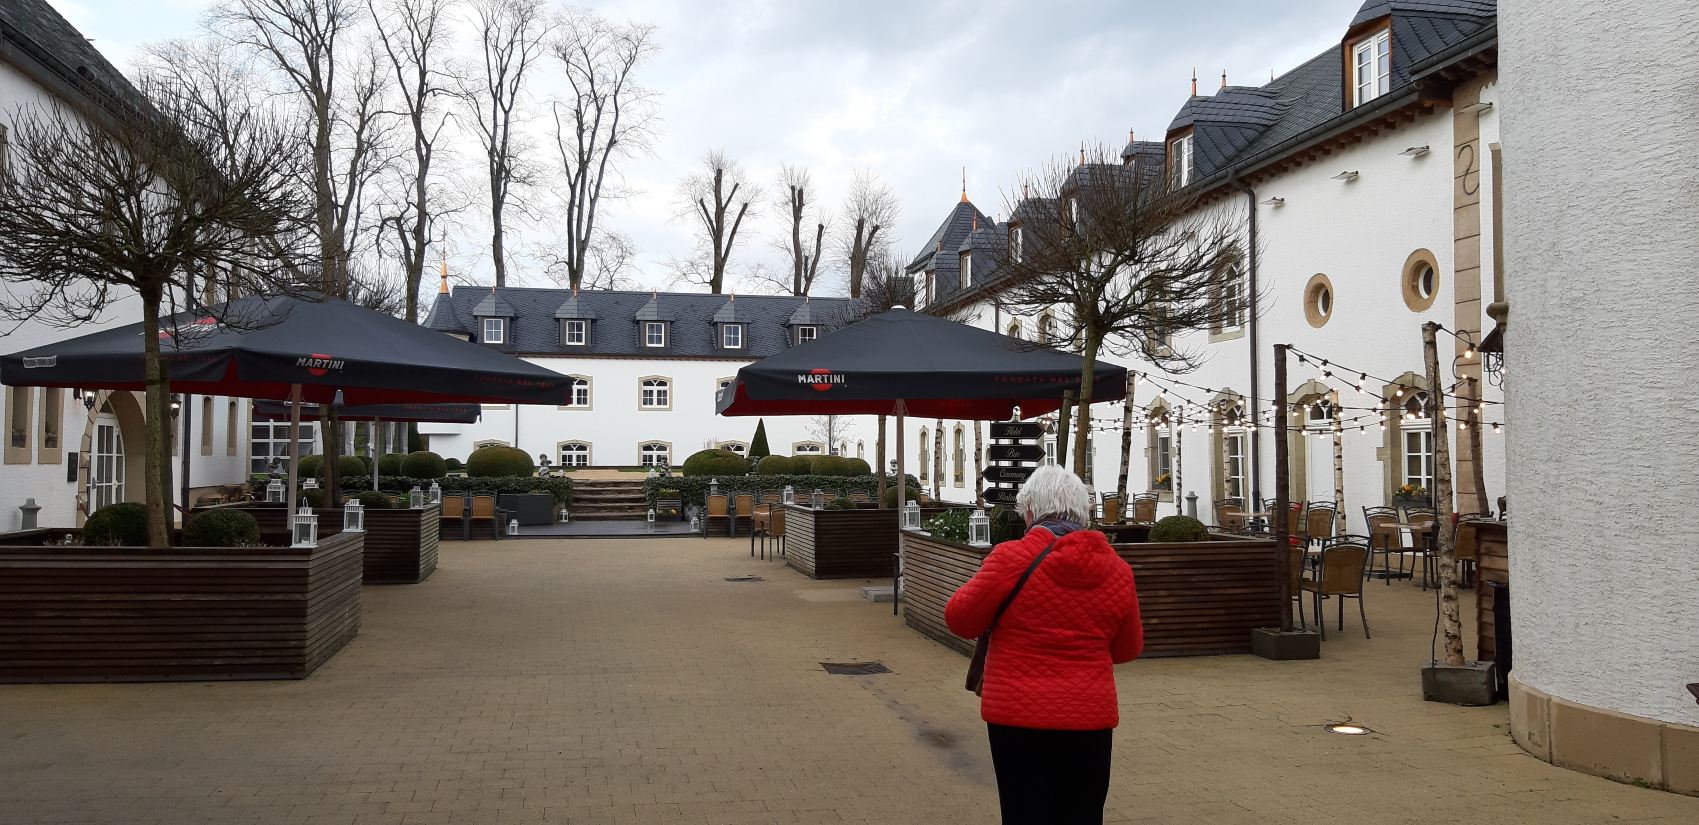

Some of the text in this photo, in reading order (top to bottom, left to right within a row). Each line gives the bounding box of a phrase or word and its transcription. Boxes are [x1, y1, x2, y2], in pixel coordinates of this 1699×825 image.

[296, 357, 344, 369] MARTINI
[798, 374, 845, 384] MARTINI
[1004, 426, 1022, 436] Hotel
[1006, 448, 1020, 458] Bar
[999, 468, 1027, 480] Ceremony
